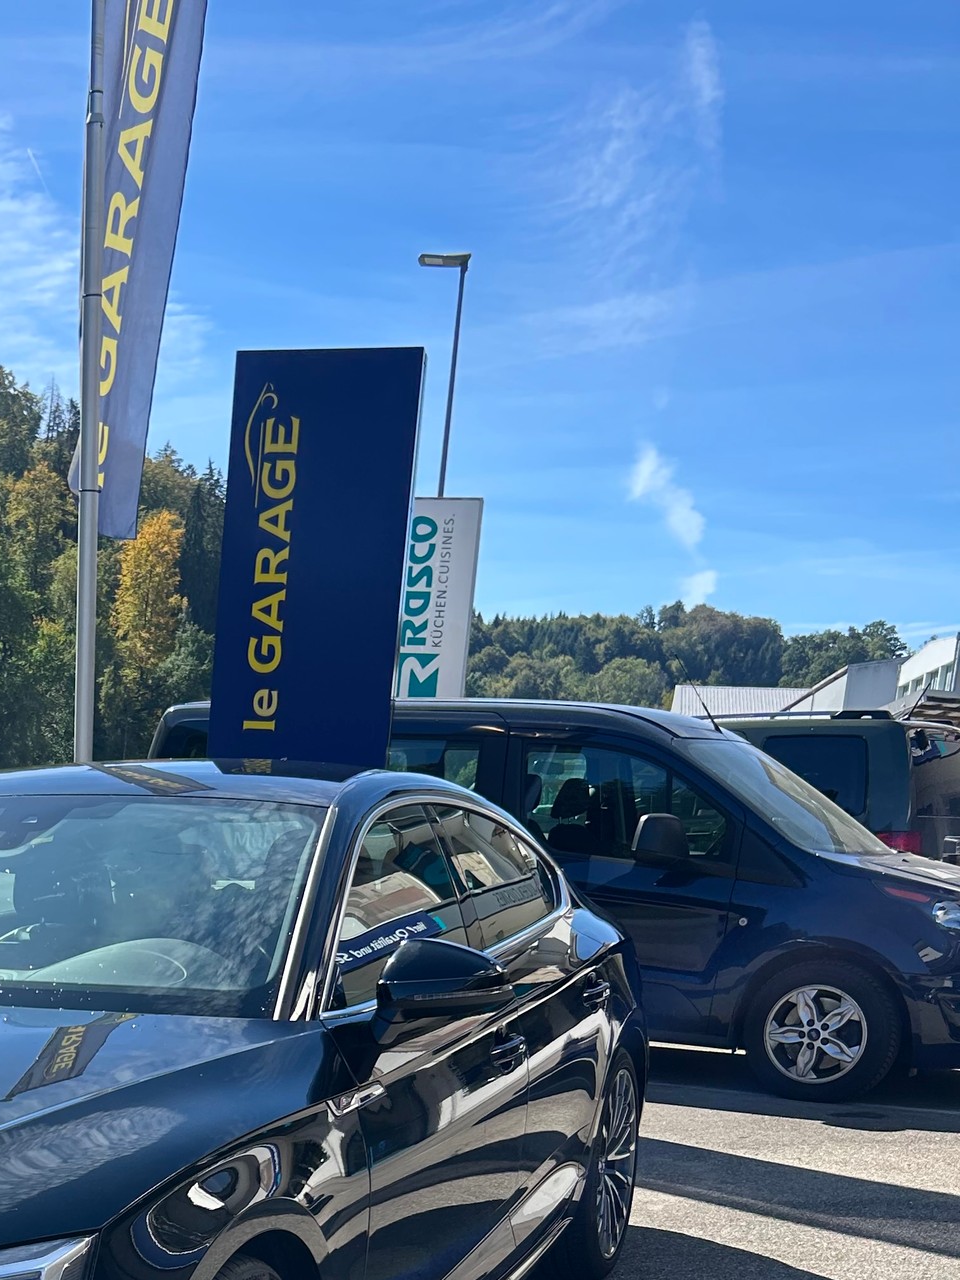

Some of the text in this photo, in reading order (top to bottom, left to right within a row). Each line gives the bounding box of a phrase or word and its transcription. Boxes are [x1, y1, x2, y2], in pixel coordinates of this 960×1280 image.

[100, 0, 174, 397] GARAGE
[247, 416, 300, 674] GARAGE
[243, 688, 279, 731] le
